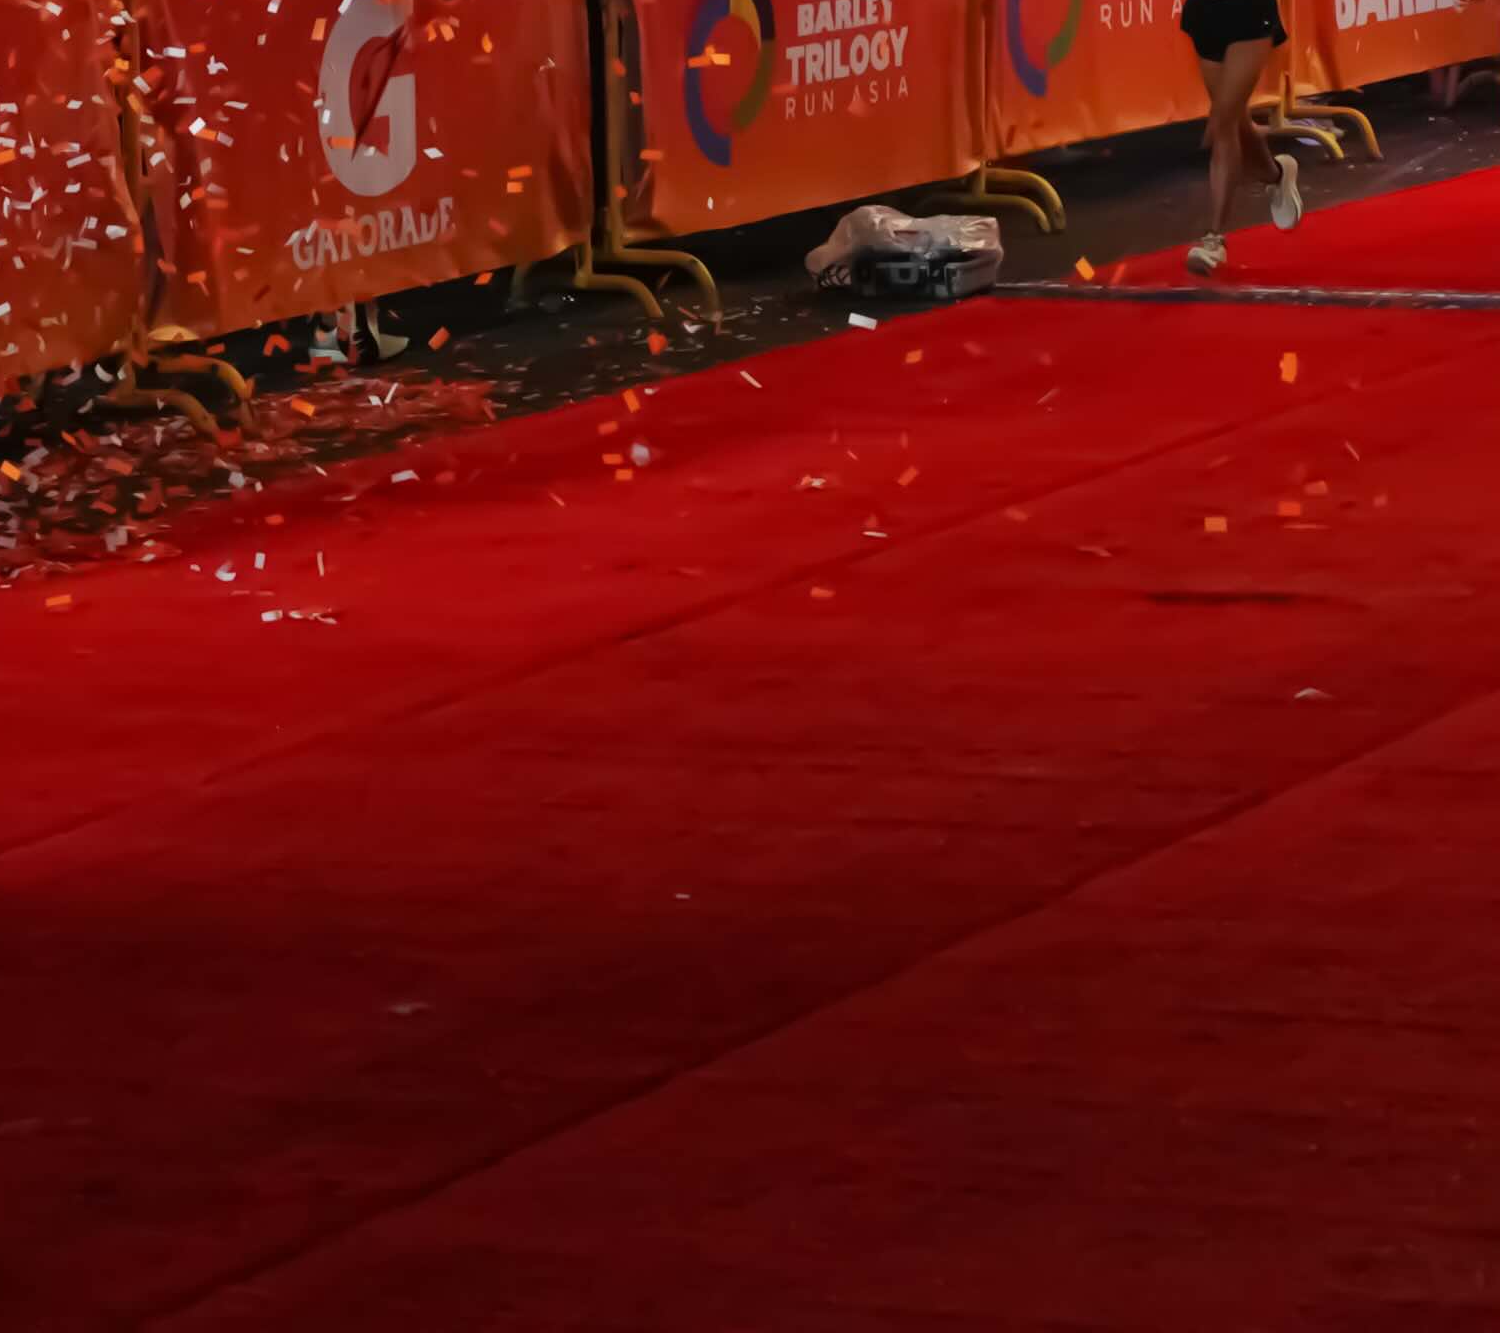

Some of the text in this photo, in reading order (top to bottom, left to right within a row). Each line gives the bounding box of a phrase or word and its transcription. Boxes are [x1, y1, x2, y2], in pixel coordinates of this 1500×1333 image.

[785, 27, 909, 85] TRILOGY
[784, 76, 909, 120] RUN ASIA
[291, 197, 456, 271] GATORADE
